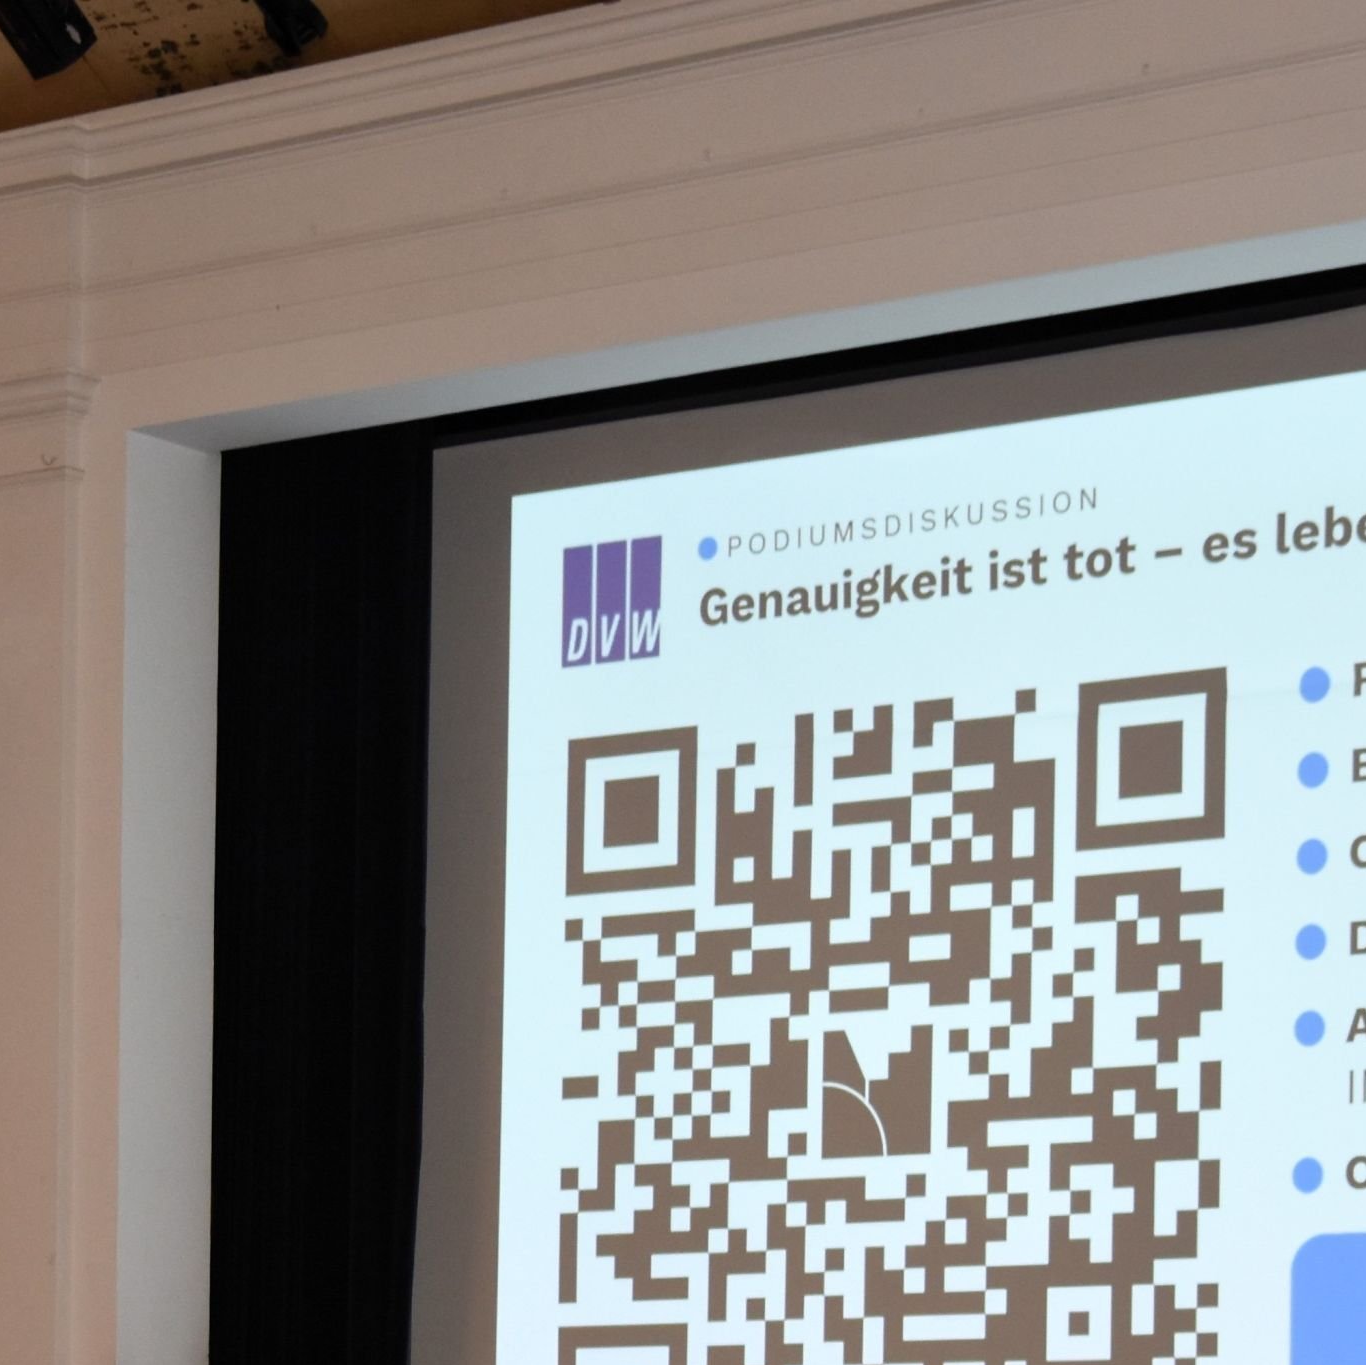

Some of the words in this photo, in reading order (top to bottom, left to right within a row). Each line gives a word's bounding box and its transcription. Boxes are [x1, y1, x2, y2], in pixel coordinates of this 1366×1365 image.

[728, 488, 1096, 557] PODIUMSDISKUSSION
[700, 555, 973, 627] Genauigkeit
[989, 547, 1048, 591] ist
[1063, 536, 1136, 581] tot
[1202, 528, 1257, 564] es
[566, 608, 662, 663] DVW
